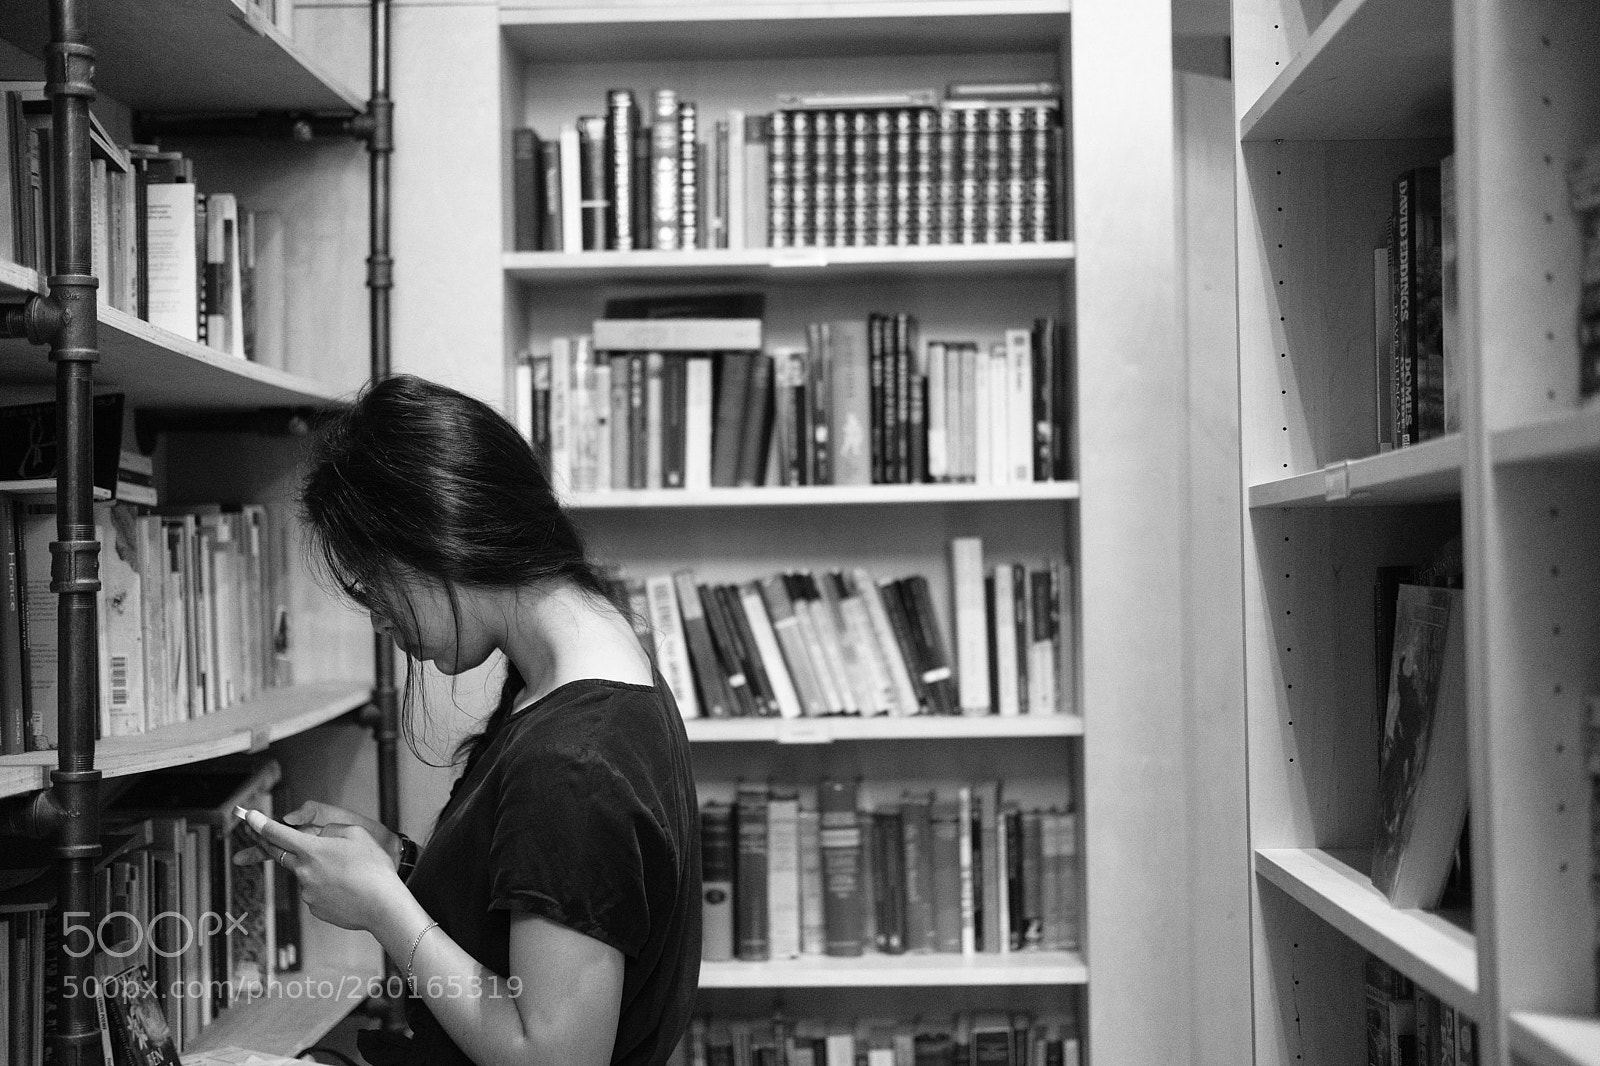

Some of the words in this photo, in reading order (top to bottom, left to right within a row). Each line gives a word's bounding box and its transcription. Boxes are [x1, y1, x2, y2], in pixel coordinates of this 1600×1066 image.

[1399, 180, 1408, 237] DAVID
[1400, 238, 1409, 323] EDDINGS
[8, 552, 16, 612] Horace
